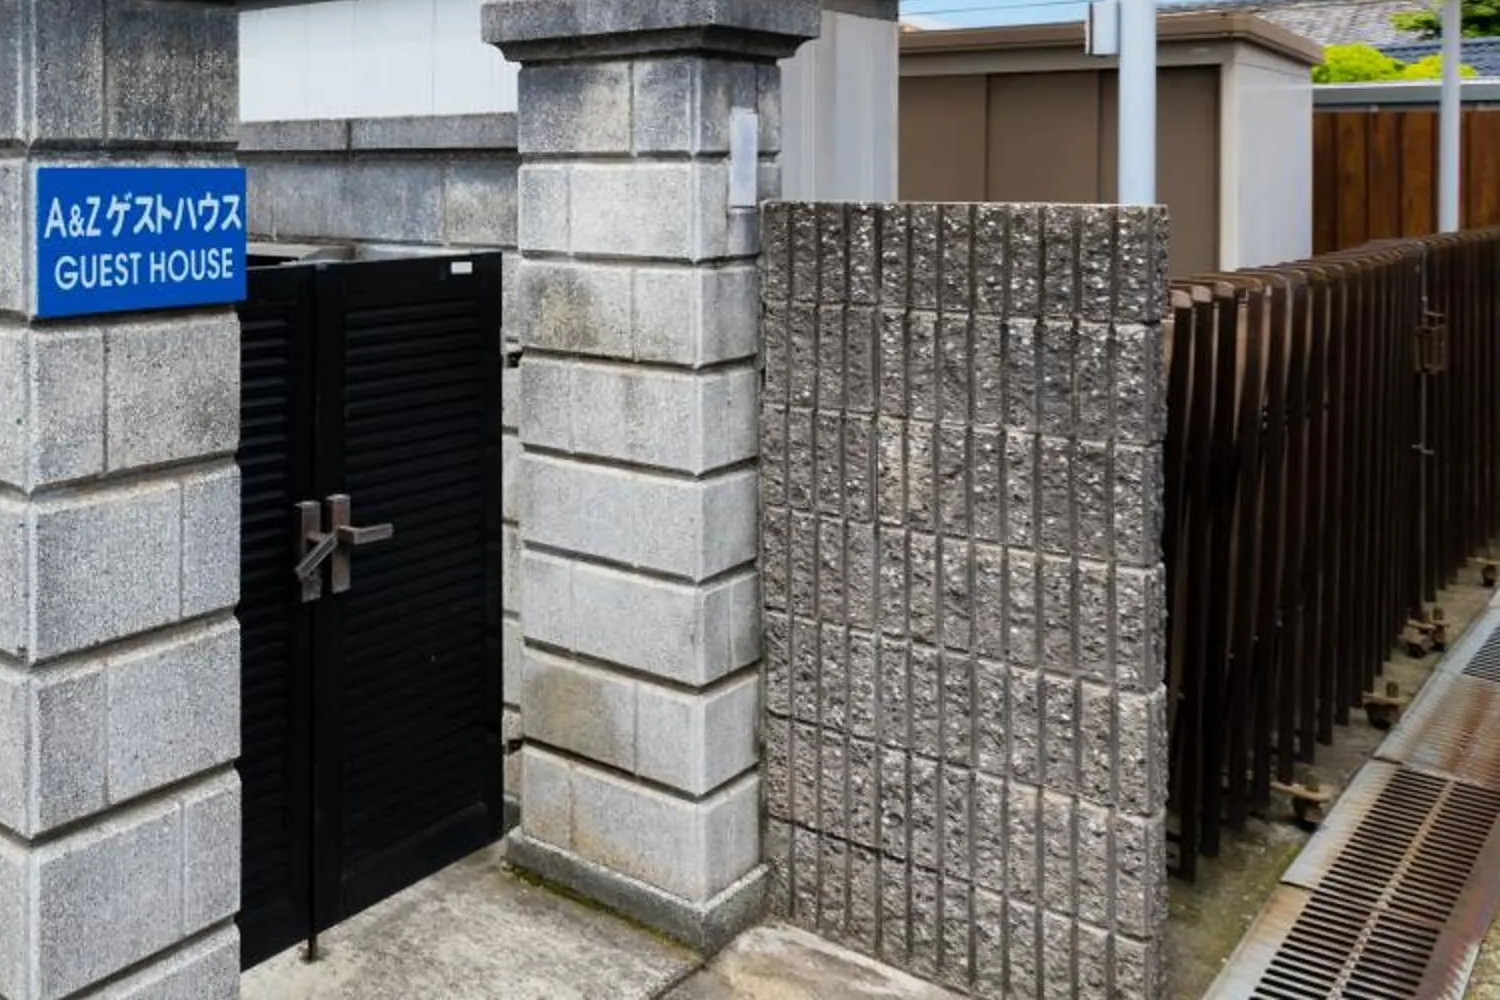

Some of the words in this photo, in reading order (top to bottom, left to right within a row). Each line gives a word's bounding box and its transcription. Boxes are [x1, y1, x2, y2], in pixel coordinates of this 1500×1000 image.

[44, 192, 242, 239] A&Zゲストハウス
[55, 252, 143, 290] GUEST
[149, 247, 233, 283] HOUSE
